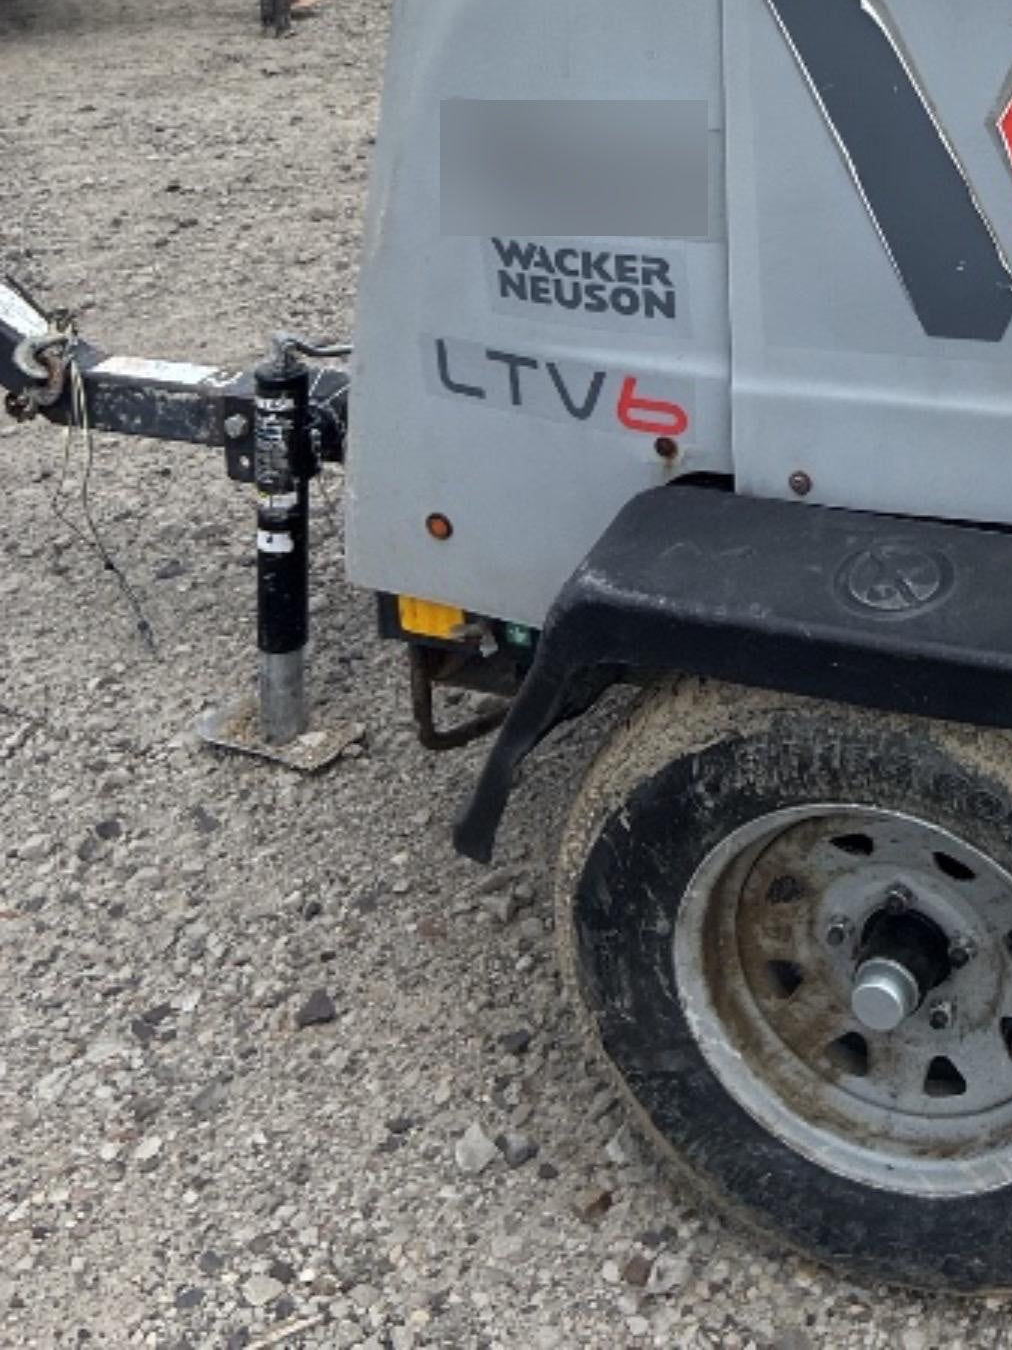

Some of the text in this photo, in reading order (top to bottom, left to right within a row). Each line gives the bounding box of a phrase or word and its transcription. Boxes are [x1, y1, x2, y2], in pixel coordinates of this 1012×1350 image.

[491, 237, 674, 288] WACKER
[498, 269, 676, 319] NEUSON
[436, 339, 689, 436] LTV6
